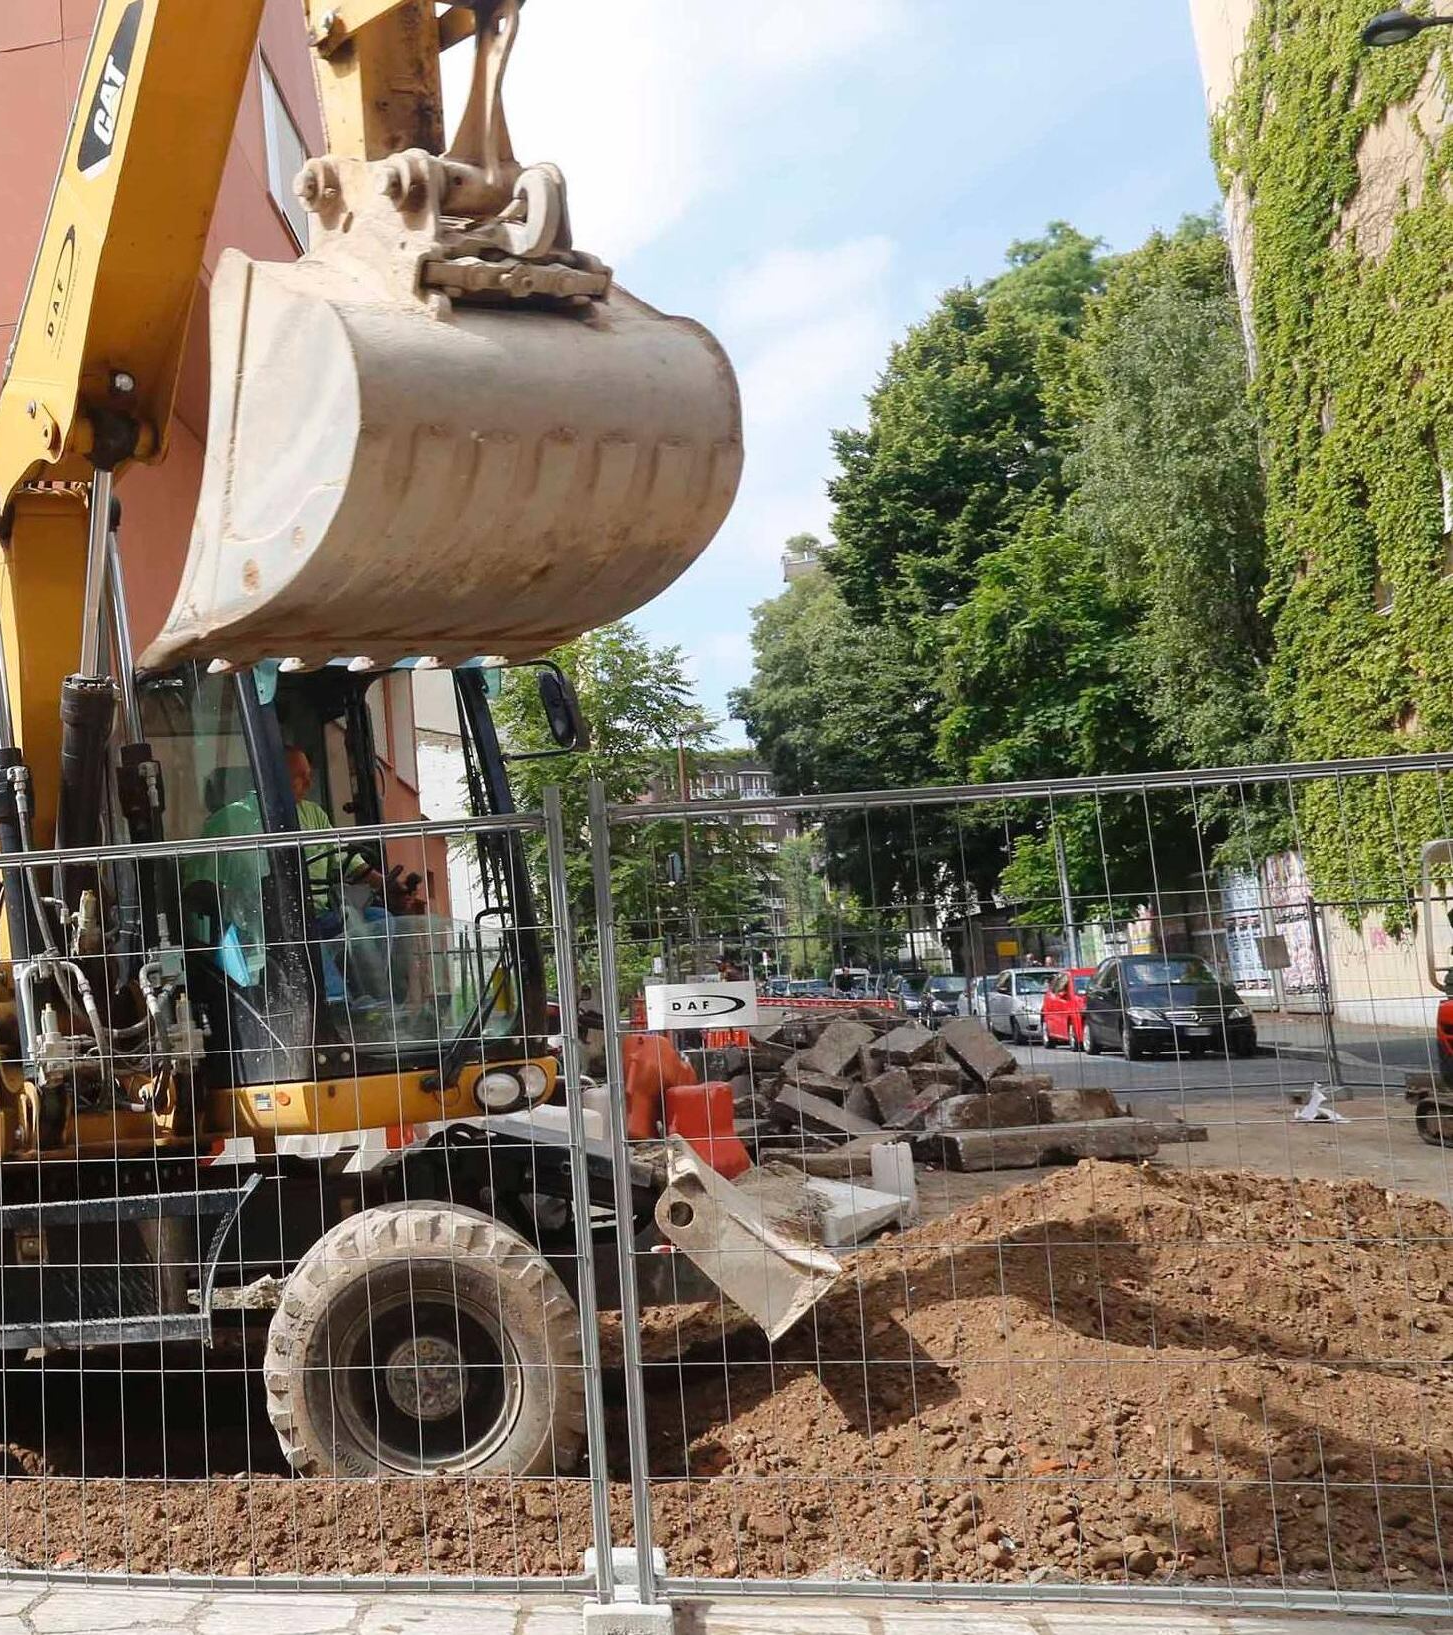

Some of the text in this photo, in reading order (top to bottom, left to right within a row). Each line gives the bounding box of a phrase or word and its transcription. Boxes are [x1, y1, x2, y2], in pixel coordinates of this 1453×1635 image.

[94, 54, 126, 146] CAT
[47, 279, 63, 337] DAF
[672, 1001, 709, 1011] DAF
